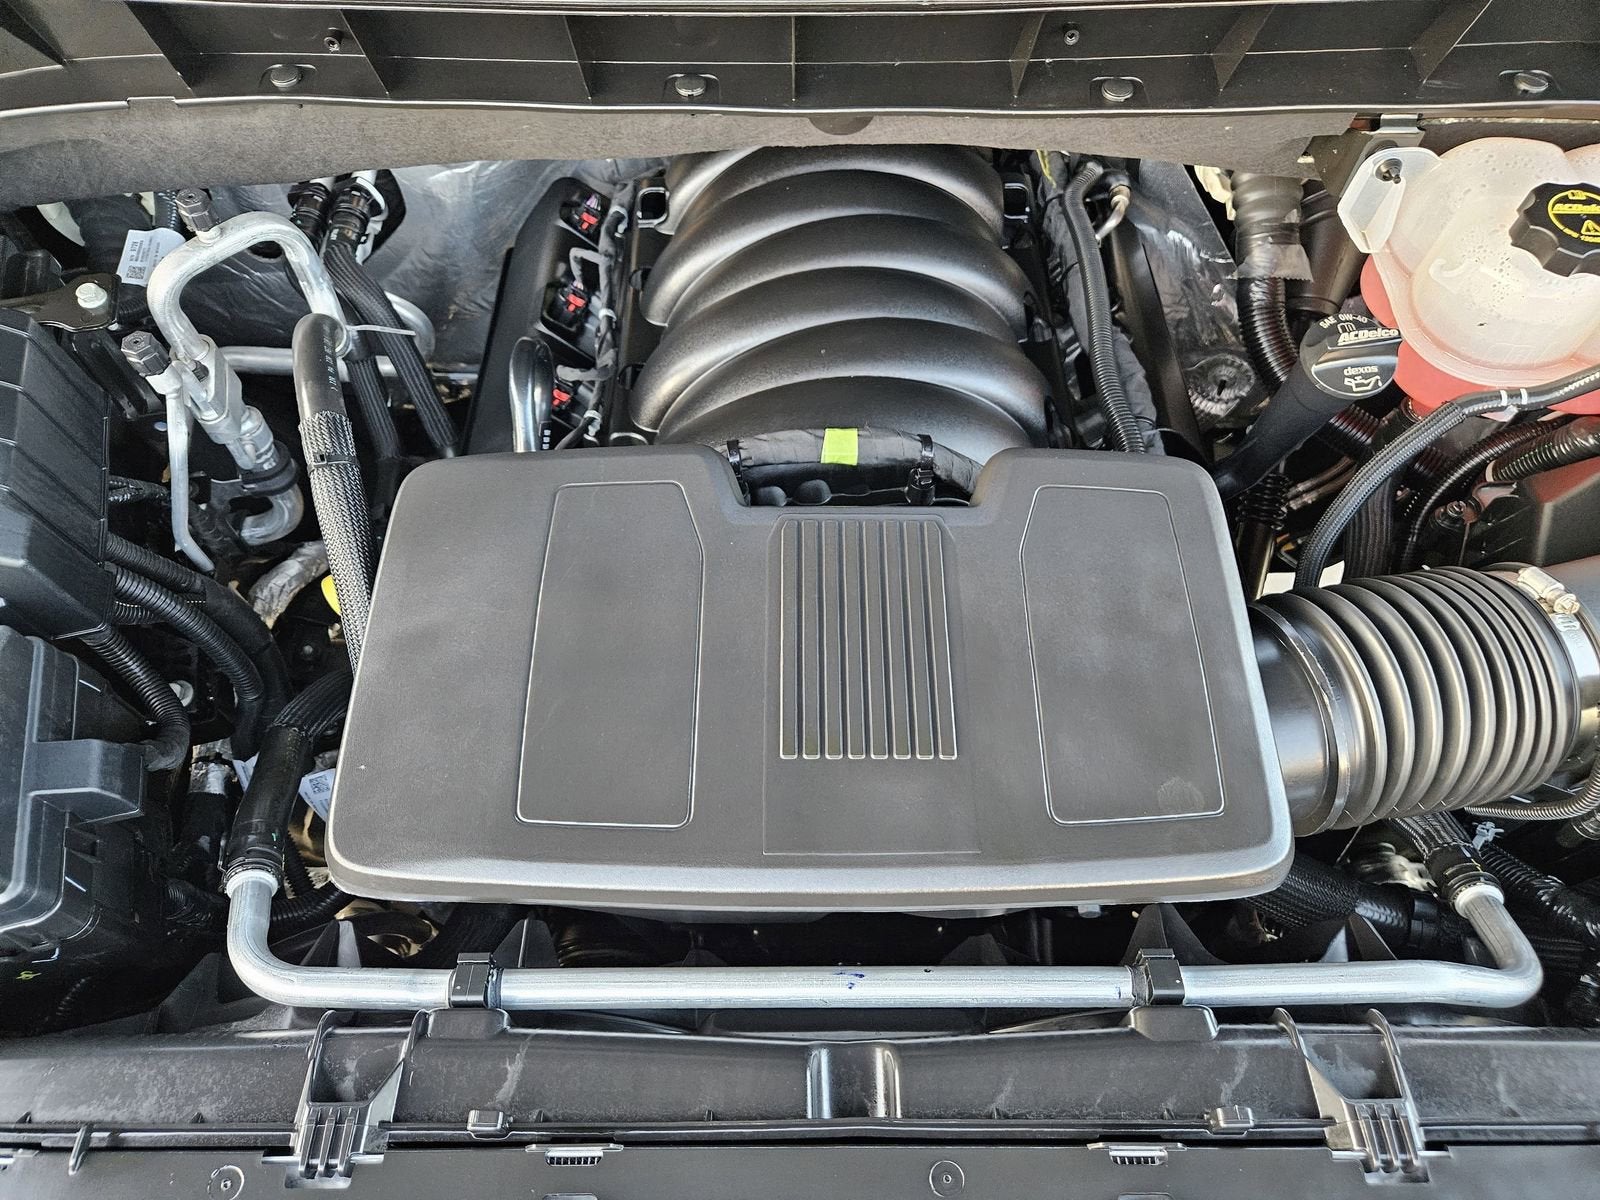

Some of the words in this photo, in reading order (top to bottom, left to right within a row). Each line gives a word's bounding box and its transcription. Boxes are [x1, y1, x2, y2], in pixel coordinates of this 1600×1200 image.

[1319, 316, 1337, 329] SAE
[1338, 328, 1399, 343] ACDelco
[1343, 365, 1379, 376] dexos
